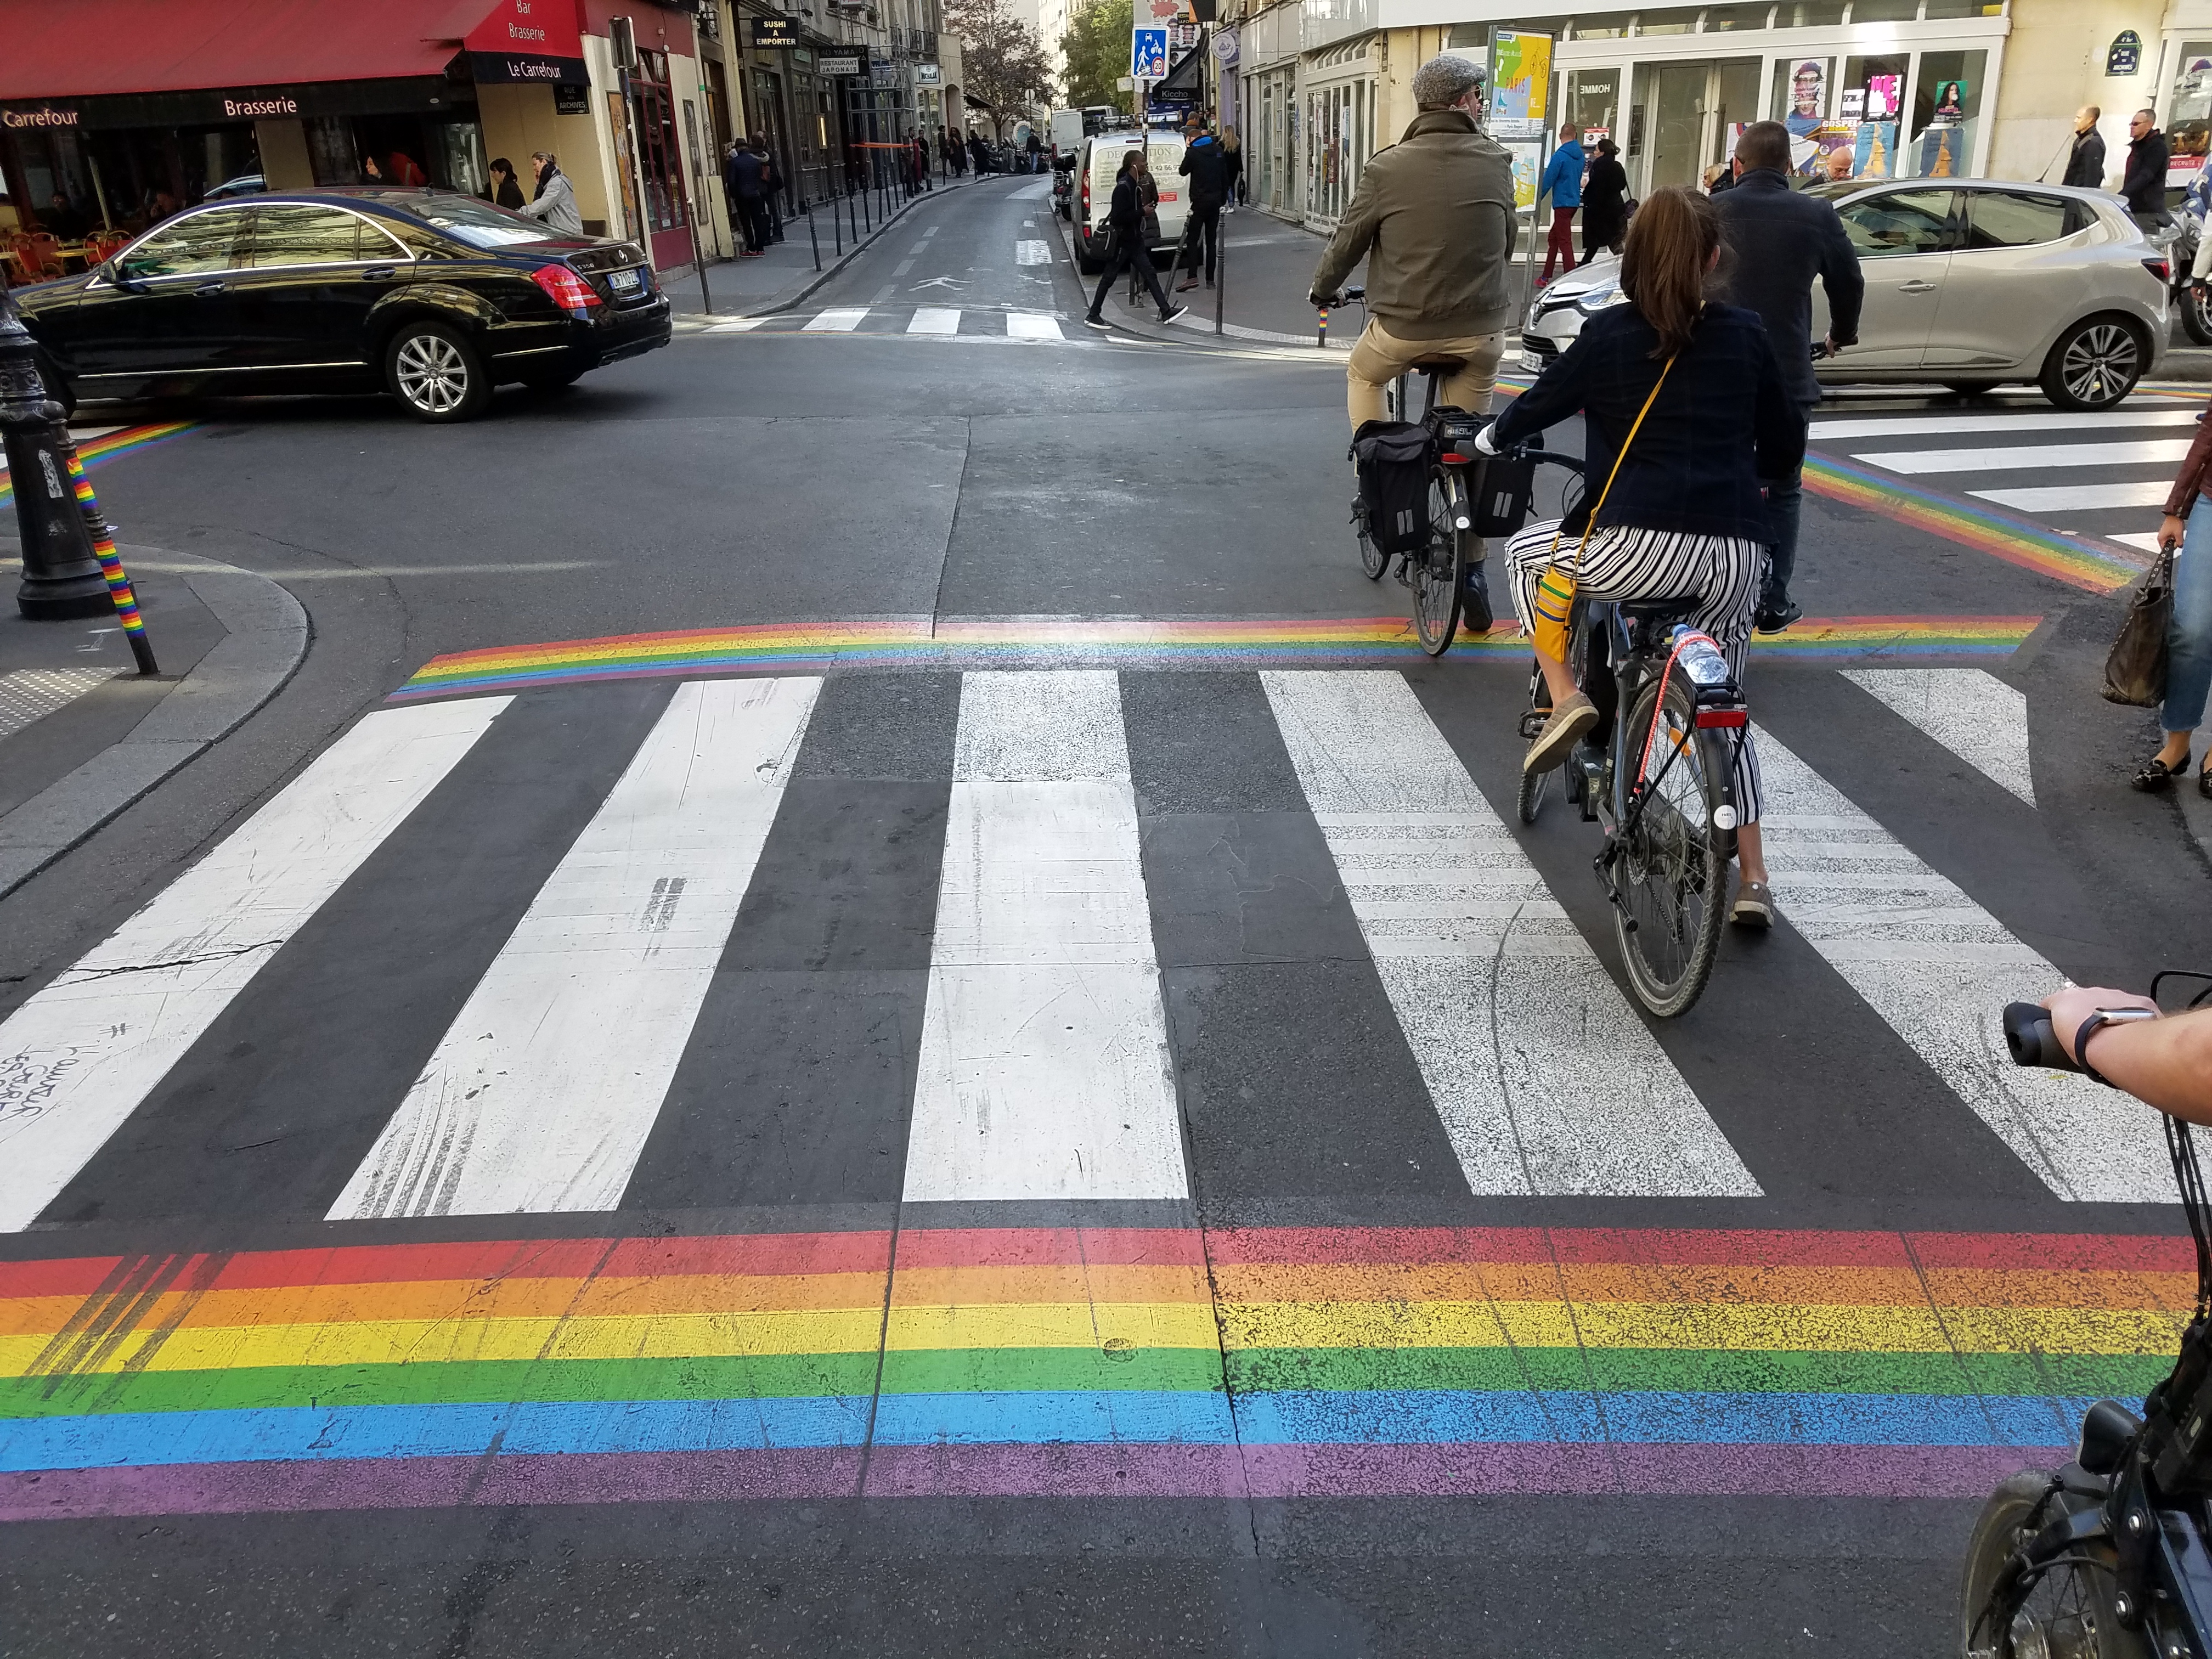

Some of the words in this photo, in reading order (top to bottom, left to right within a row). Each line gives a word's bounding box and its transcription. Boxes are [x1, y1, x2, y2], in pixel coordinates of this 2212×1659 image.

[516, 0, 531, 14] Bar
[509, 22, 545, 41] Brasserie
[507, 61, 521, 76] Le
[521, 61, 562, 78] Carrefour
[1505, 77, 1525, 94] PARIS
[224, 96, 297, 116] Brasserie
[2, 108, 78, 127] Carrefour
[1821, 120, 1858, 128] GOSPEL
